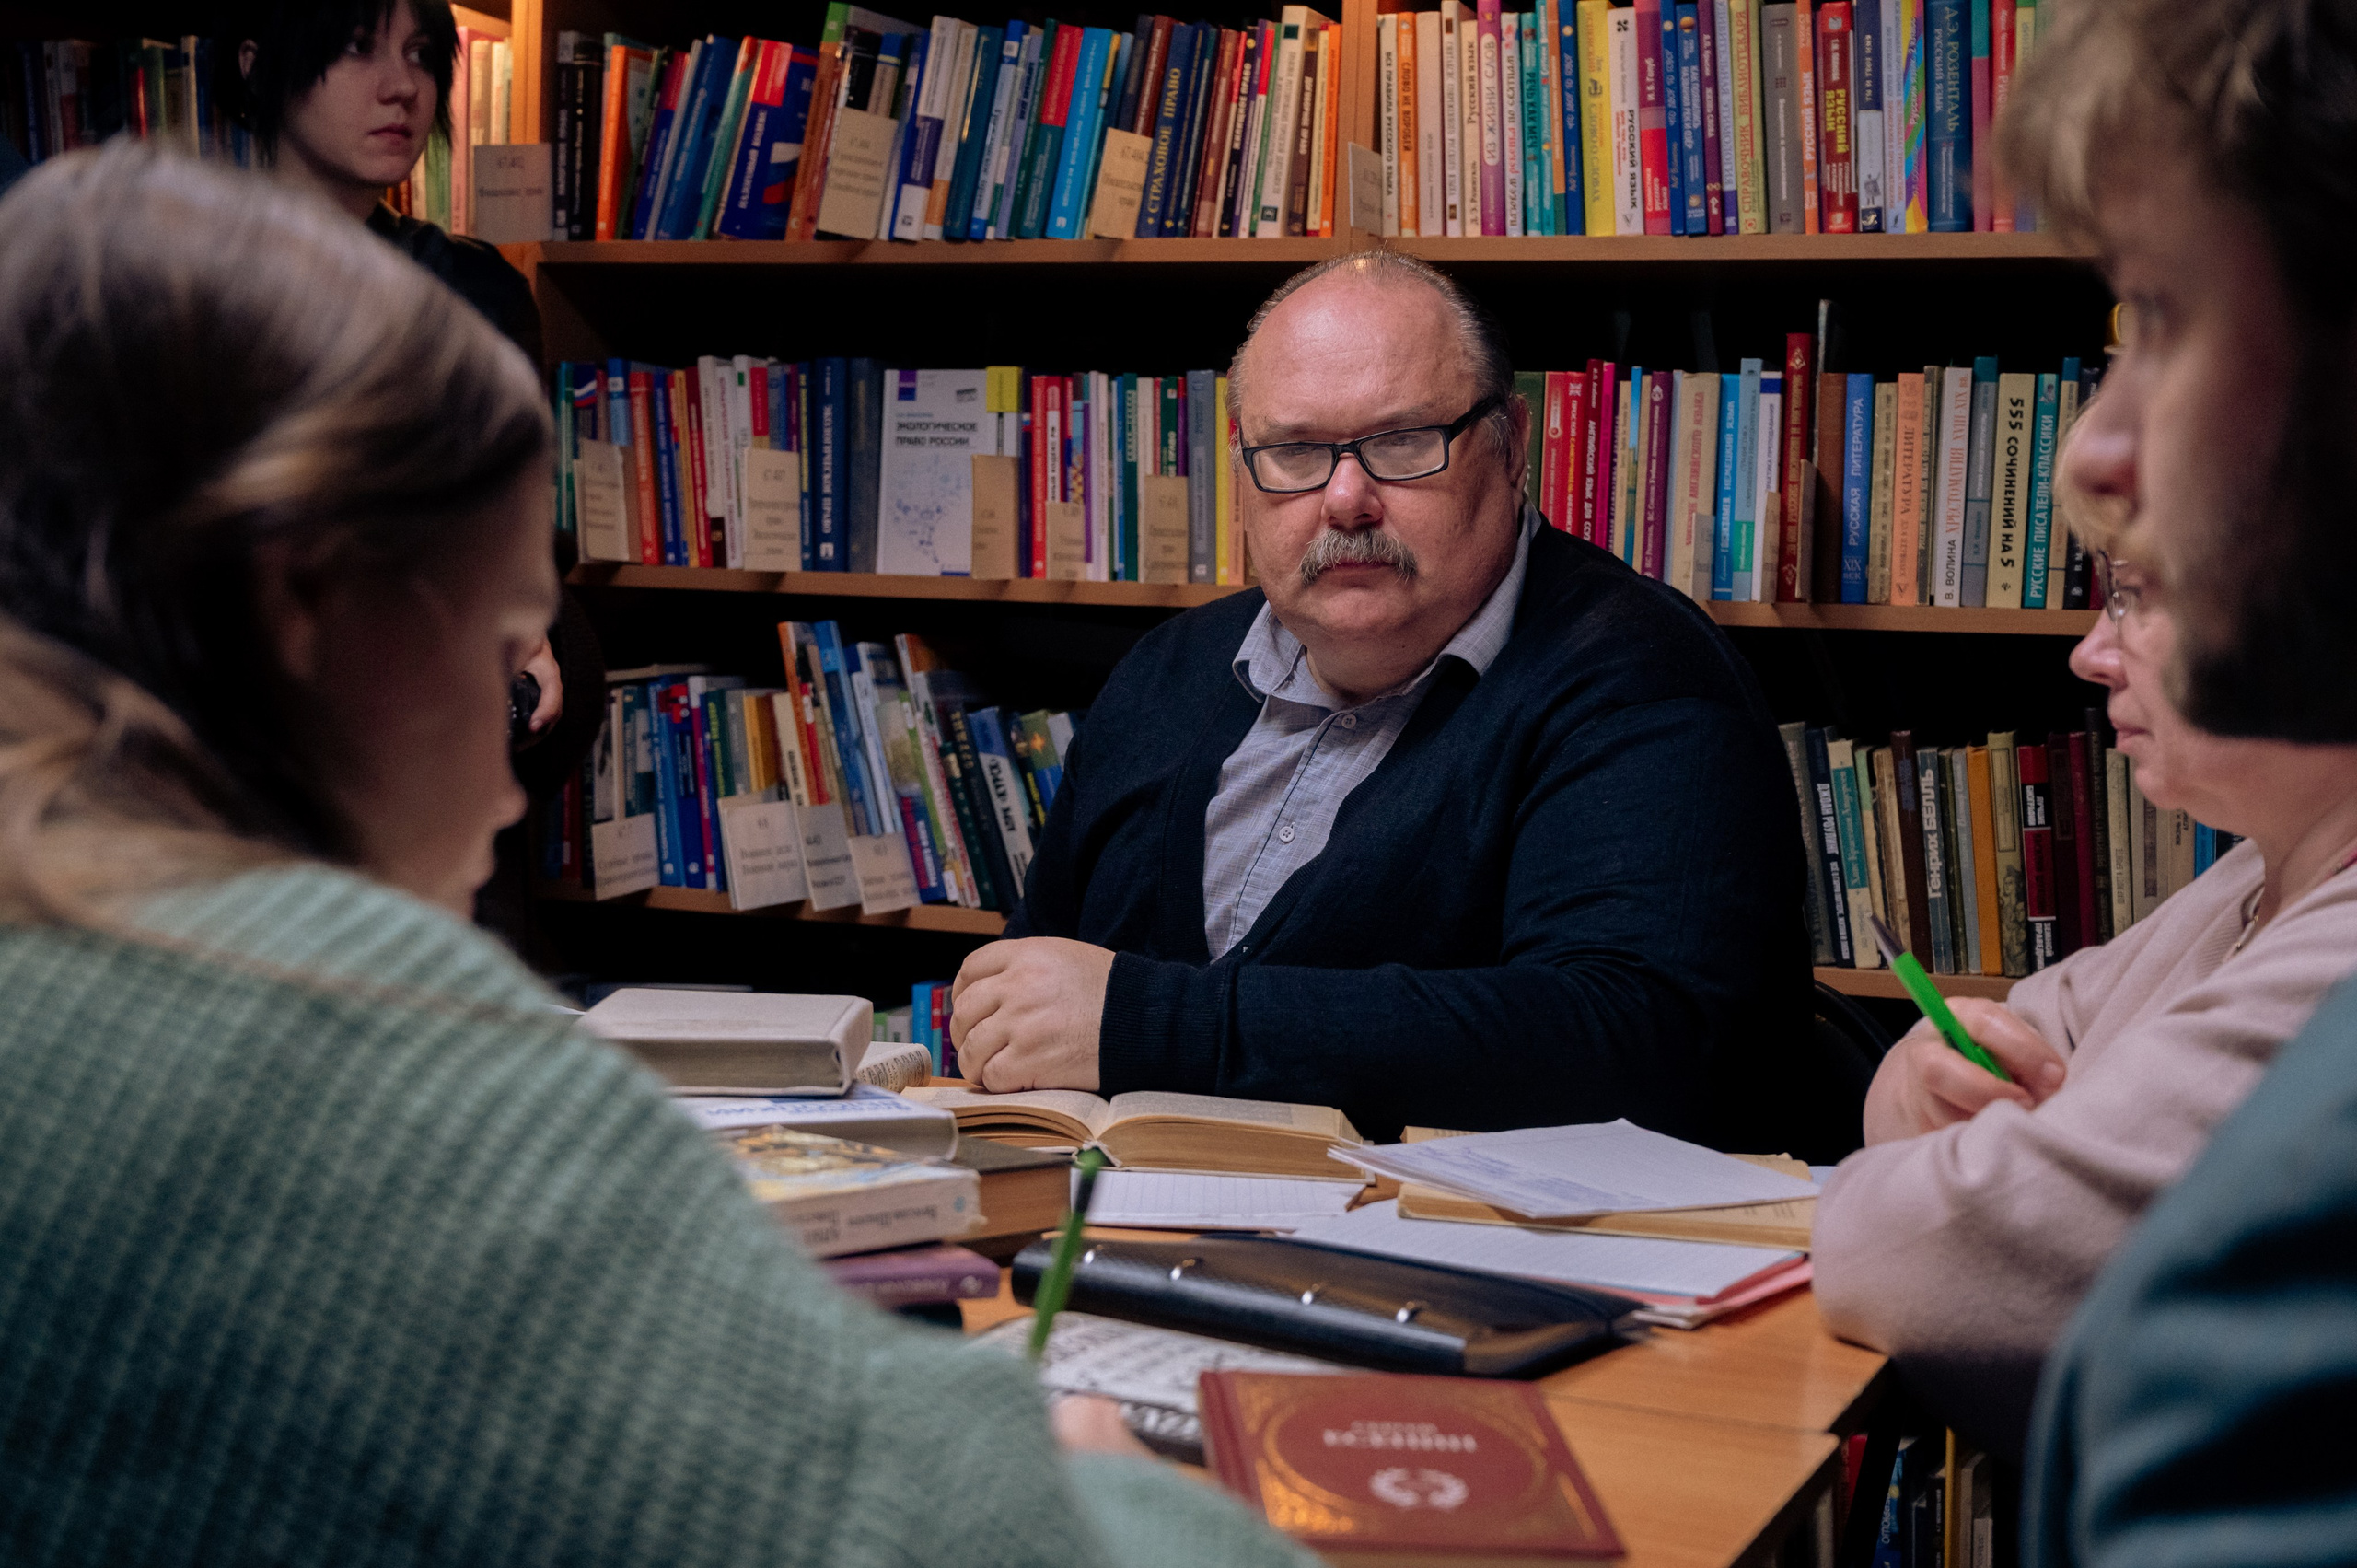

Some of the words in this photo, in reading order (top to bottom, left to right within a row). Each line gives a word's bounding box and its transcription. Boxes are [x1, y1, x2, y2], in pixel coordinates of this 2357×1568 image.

[1466, 41, 1475, 72] язык
[1485, 41, 1495, 79] СЛОВ
[1735, 10, 1748, 116] БИБЛИОТЕКАРЯ
[1934, 29, 1945, 81] РУССКИЙ
[1239, 62, 1251, 95] ПРАВО
[1402, 61, 1411, 93] СЛОВО
[1526, 72, 1536, 99] РЕЧЬ
[1802, 71, 1813, 104] ЯЗЫК
[1946, 41, 1961, 132] РОЗЕНТАЛЬ
[1403, 95, 1411, 107] НЕ
[1466, 75, 1479, 124] Русский
[1486, 87, 1496, 135] ЖИЗНИ
[1508, 111, 1515, 124] по
[1527, 101, 1536, 123] КАК
[1826, 90, 1836, 132] ЯЗЫК
[1935, 84, 1944, 113] ЯЗЫК
[1146, 125, 1172, 214] СТРАХОВОЕ
[1162, 68, 1181, 118] ПРАВО
[1403, 110, 1412, 152] ВОРОБЕЙ
[1527, 125, 1538, 149] МЕЧ
[1589, 103, 1598, 144] СЛОВО
[1629, 110, 1638, 168] РУССКИЙ
[1801, 108, 1815, 161] РУССКИЙ
[1836, 88, 1848, 154] РУССКИЙ
[1298, 128, 1309, 155] ПРАВО
[1487, 142, 1497, 158] ИЗ
[1739, 125, 1752, 214] СПРАВОЧНИК
[1508, 178, 1518, 227] назовем
[1654, 177, 1662, 212] русского
[896, 422, 977, 432] ЭКОЛОГИЧЕСКОЕ
[1692, 391, 1704, 426] ЯЗЫКА
[1725, 401, 1736, 429] ЯЗЫК
[2009, 397, 2024, 431] 555
[822, 404, 833, 494] ЭКОЛОГИЧЕСКОЕ
[896, 436, 926, 447] ПРАВО
[928, 436, 970, 446] РОССИИ
[1167, 431, 1177, 462] ПРАВО
[1586, 420, 1596, 475] АНГЛИЙСКИЙ
[1767, 403, 1775, 458] ПРЕПОДАВАНИЯ
[1851, 397, 1864, 477] ЛИТЕРАТУРА
[1689, 429, 1702, 499] АНГЛИЙСКОГО
[1723, 433, 1734, 490] НЕМЕЦКИЙ
[1899, 425, 1916, 515] ЛИТЕРАТУРА
[2033, 414, 2054, 542] ПИСАТЕЛИ-КЛАССИКИ
[1585, 477, 1594, 500] ЯЗЫК
[1945, 447, 1965, 534] ХРЕСТОМАТИЯ
[2003, 436, 2019, 528] СОЧИНЕНИЙ
[822, 497, 833, 534] ПРАВО
[1584, 501, 1593, 519] ДЛЯ
[1848, 488, 1861, 546] РУССКАЯ
[2001, 532, 2013, 553] НА
[2001, 557, 2014, 567] 5
[1843, 558, 1862, 572] XIX
[1945, 539, 1957, 587] ВОЛИНА
[2029, 546, 2046, 598] РУССКИЕ
[1945, 588, 1955, 599] В.
[1817, 783, 1834, 816] ДЖОАН
[1920, 768, 1937, 830] БЕЛЛЬ
[1822, 816, 1840, 855] РОУЛИНГ
[1926, 831, 1942, 900] Генрих
